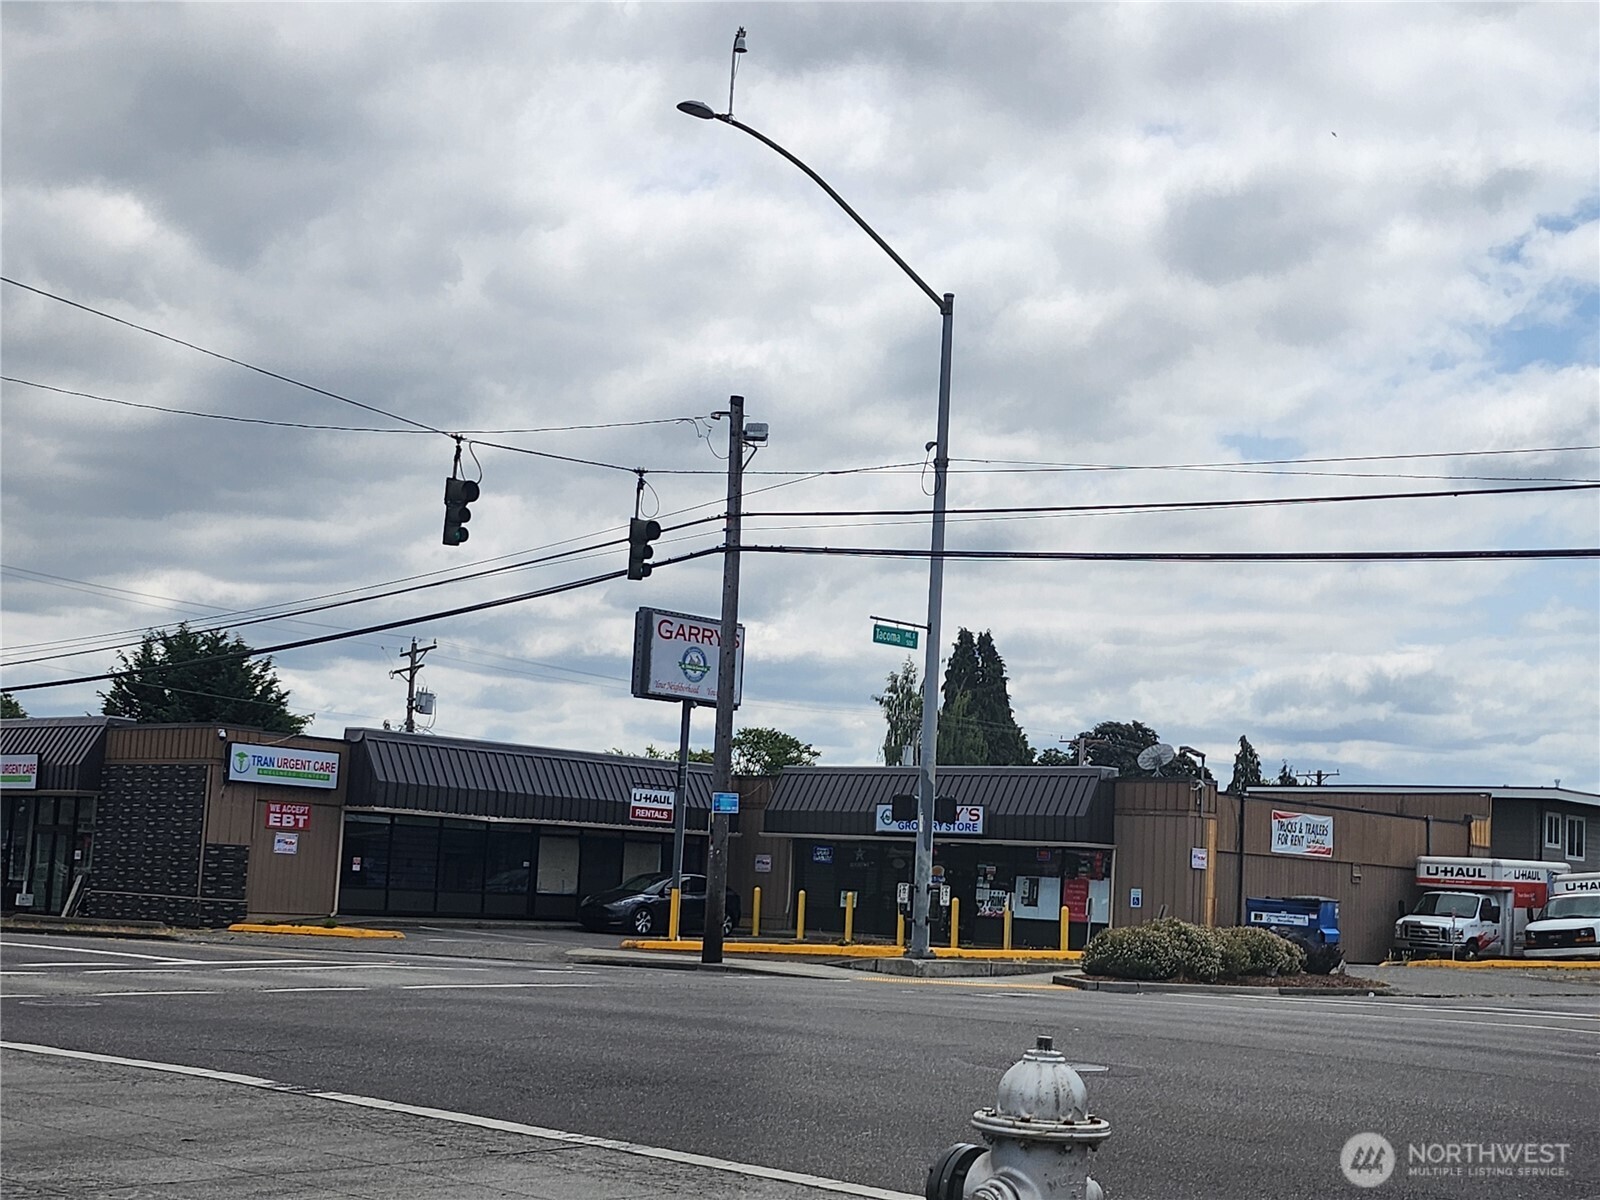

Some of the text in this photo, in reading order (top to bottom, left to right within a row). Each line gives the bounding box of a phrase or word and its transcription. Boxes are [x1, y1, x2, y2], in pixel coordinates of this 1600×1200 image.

[876, 628, 900, 643] Tacoma
[655, 680, 666, 689] Your
[666, 681, 700, 694] Neighborhood
[22, 763, 37, 774] CARE
[252, 755, 336, 773] TRAN URGENT CARE
[633, 793, 673, 805] U-HAUL
[270, 804, 309, 814] WE ACCEPT
[635, 809, 668, 819] RENTALS
[269, 813, 308, 828] EBT
[898, 821, 978, 832] GRORY STORE
[1277, 820, 1328, 837] TRUCKS & TRAILERS
[1277, 833, 1304, 847] FOR RENT
[1426, 865, 1486, 878] U-HAUL
[1514, 869, 1541, 881] U-HAUL
[1565, 881, 1600, 891] U-HA
